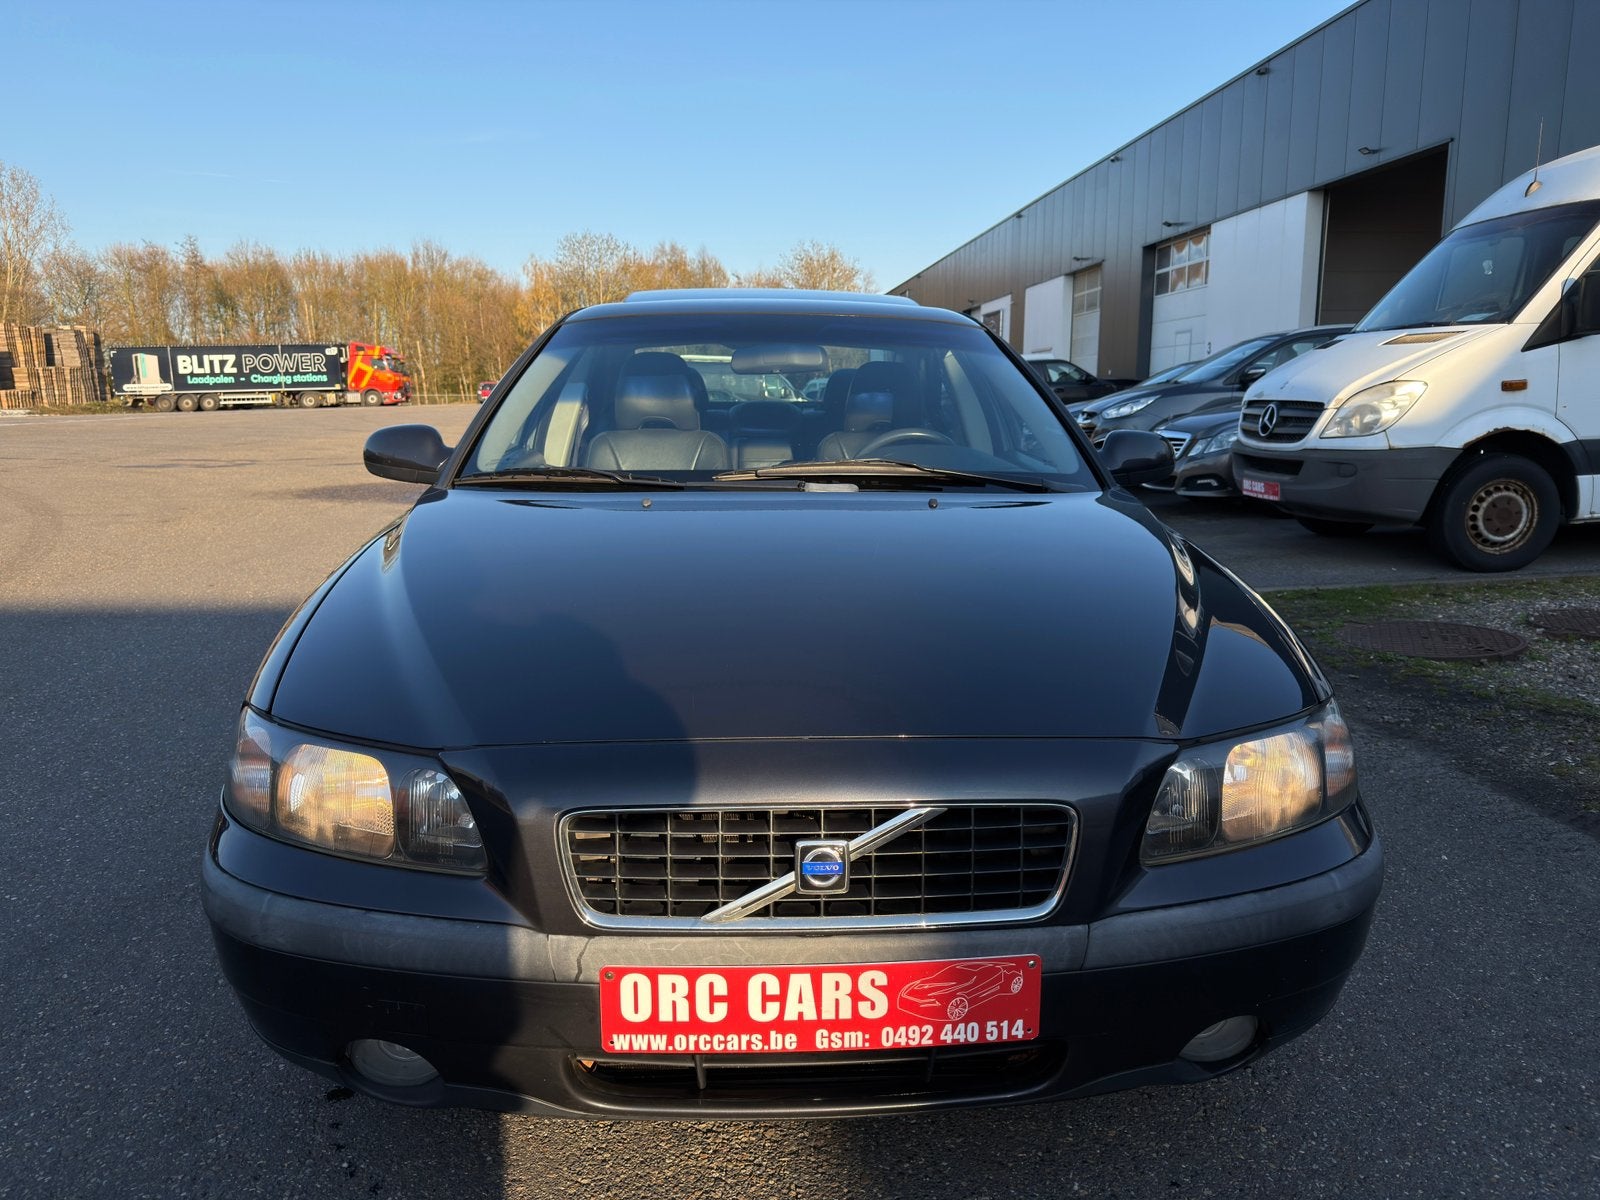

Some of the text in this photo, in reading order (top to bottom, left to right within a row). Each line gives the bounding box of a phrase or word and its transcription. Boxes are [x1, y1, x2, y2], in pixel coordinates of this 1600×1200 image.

[177, 353, 327, 374] BLITZ POWER
[187, 375, 235, 385] Laadpalen
[250, 373, 292, 384] Charging
[293, 373, 328, 382] stations
[619, 970, 889, 1023] ORC CARS
[612, 1018, 1026, 1052] www.orccars.be Gsm: 0492 440 514
